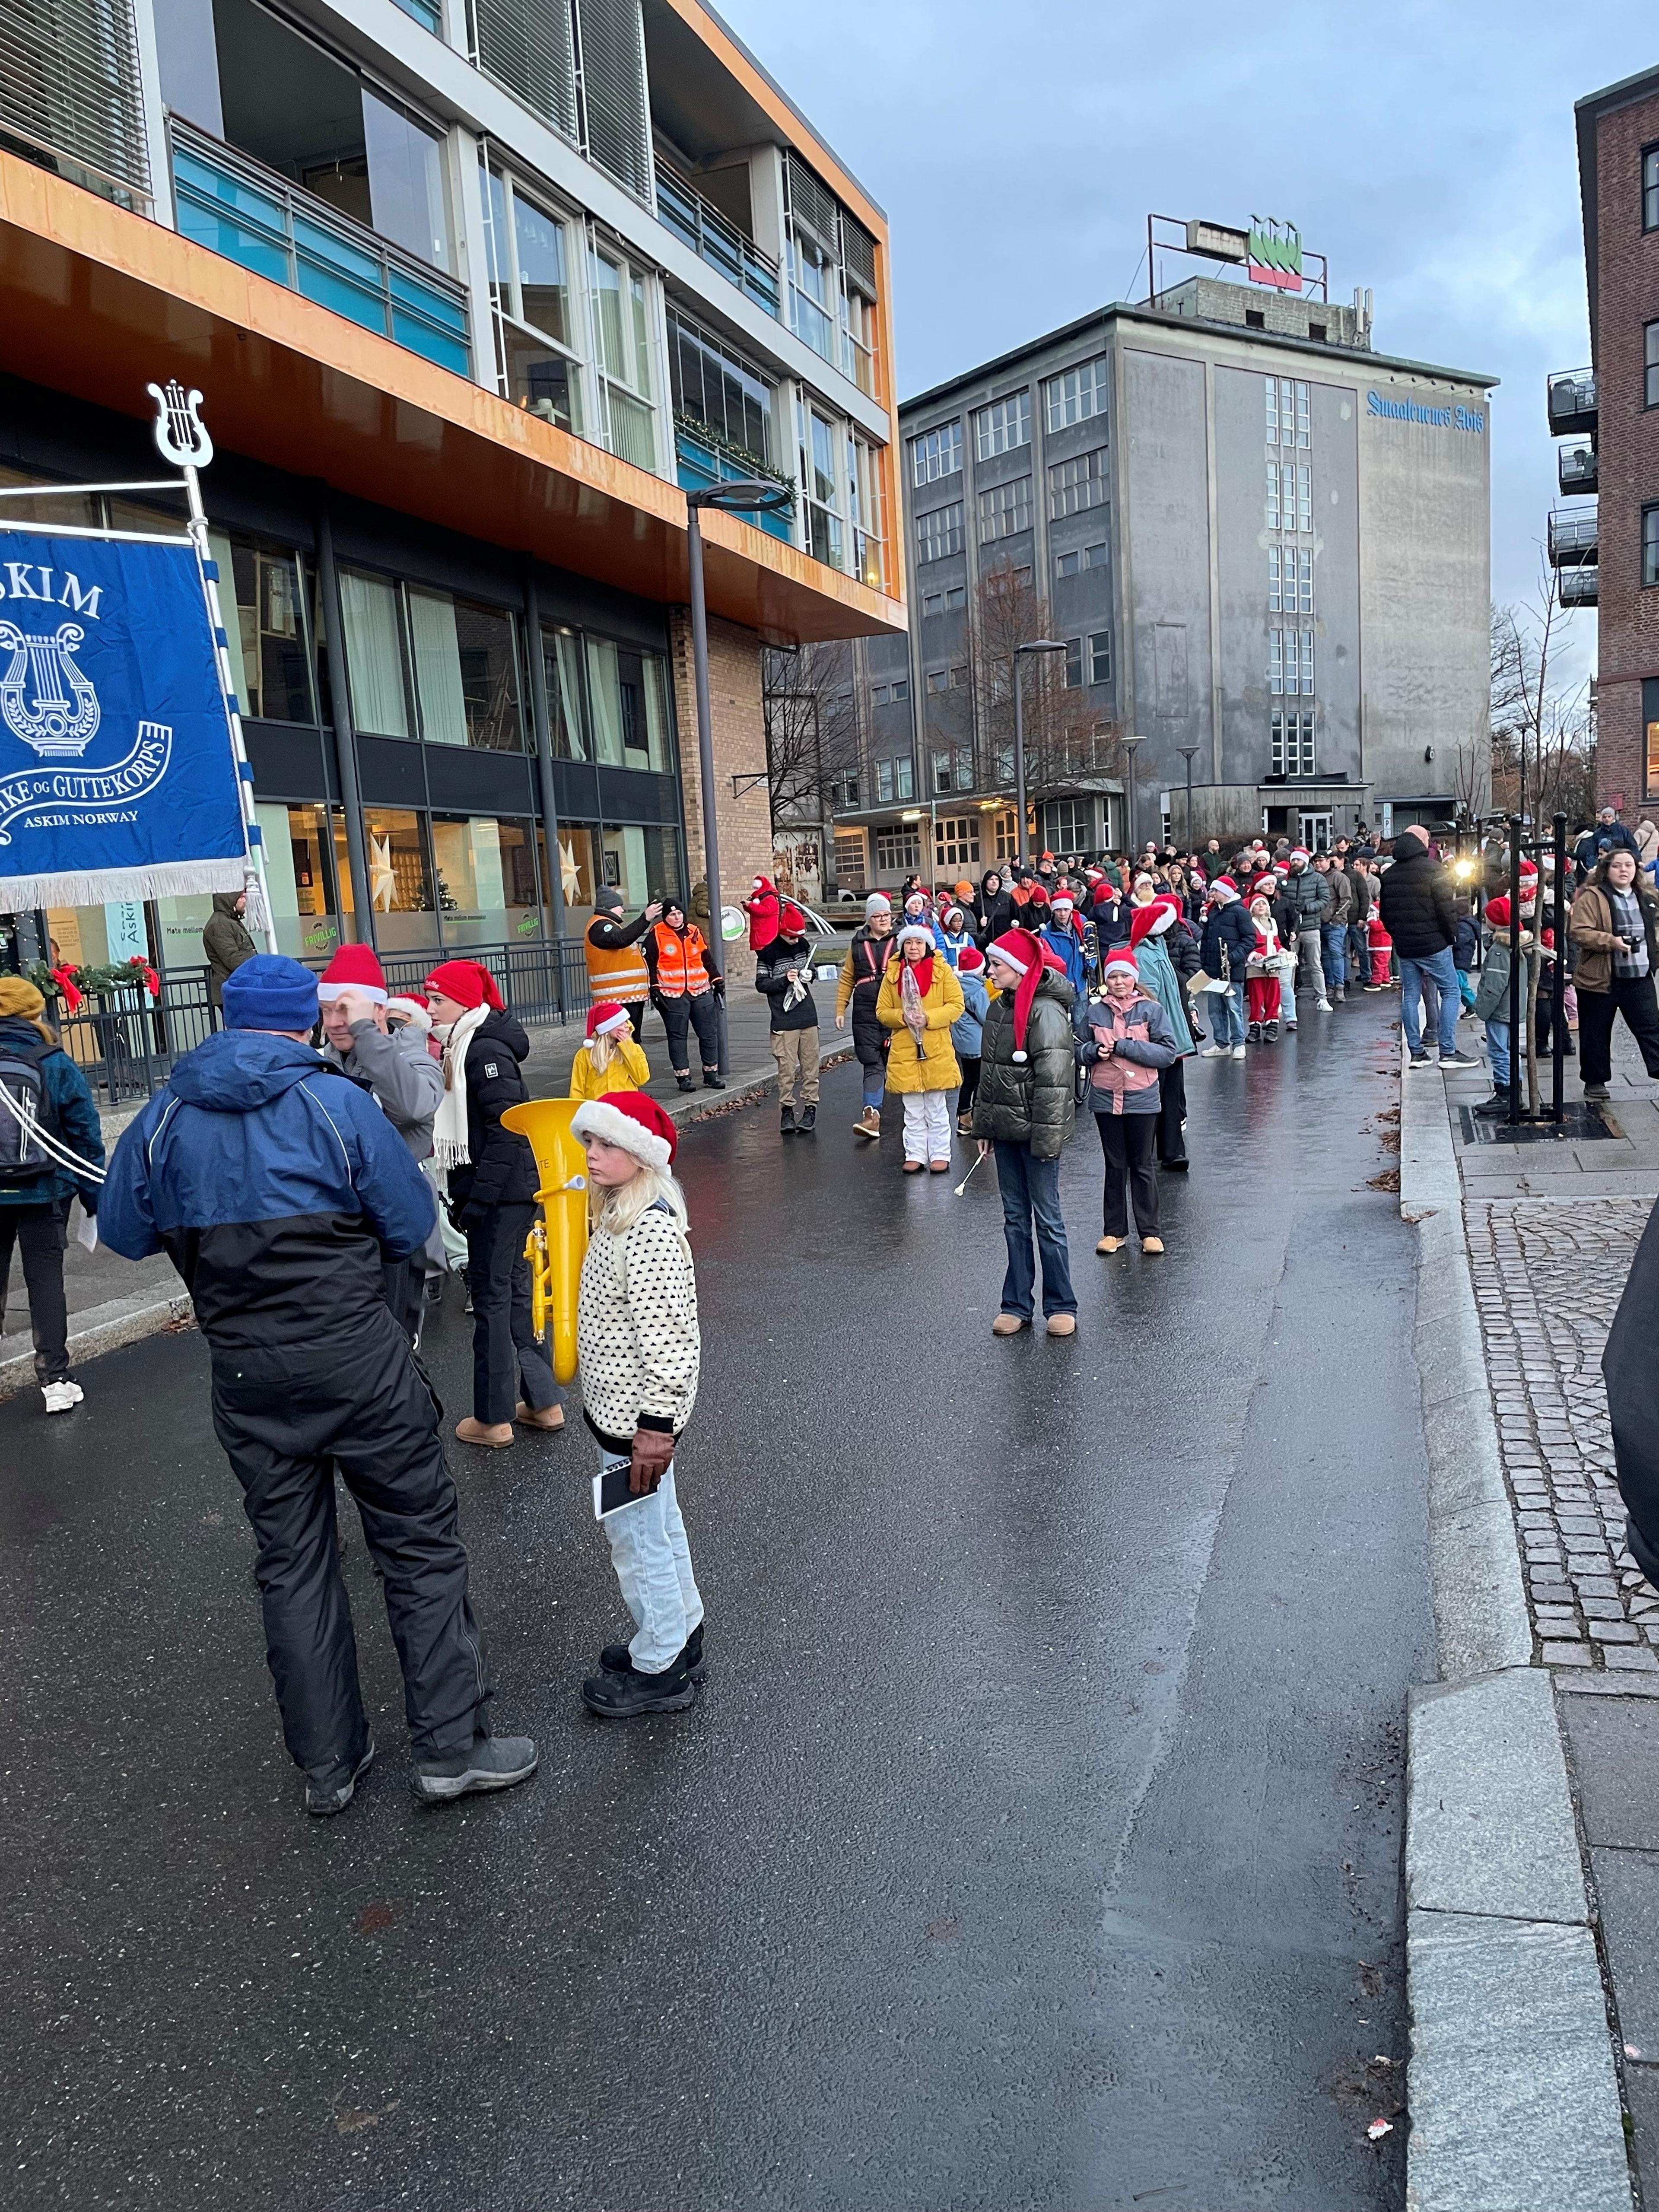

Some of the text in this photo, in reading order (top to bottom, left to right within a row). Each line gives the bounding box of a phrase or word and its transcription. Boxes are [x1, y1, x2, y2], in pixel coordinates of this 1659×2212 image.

[1367, 389, 1484, 434] Smaalenenes Avis
[0, 741, 165, 816] IKE OG GUTTEKORPS
[24, 810, 138, 828] ASKIM NORWAY
[304, 927, 336, 947] FRIVILLIG
